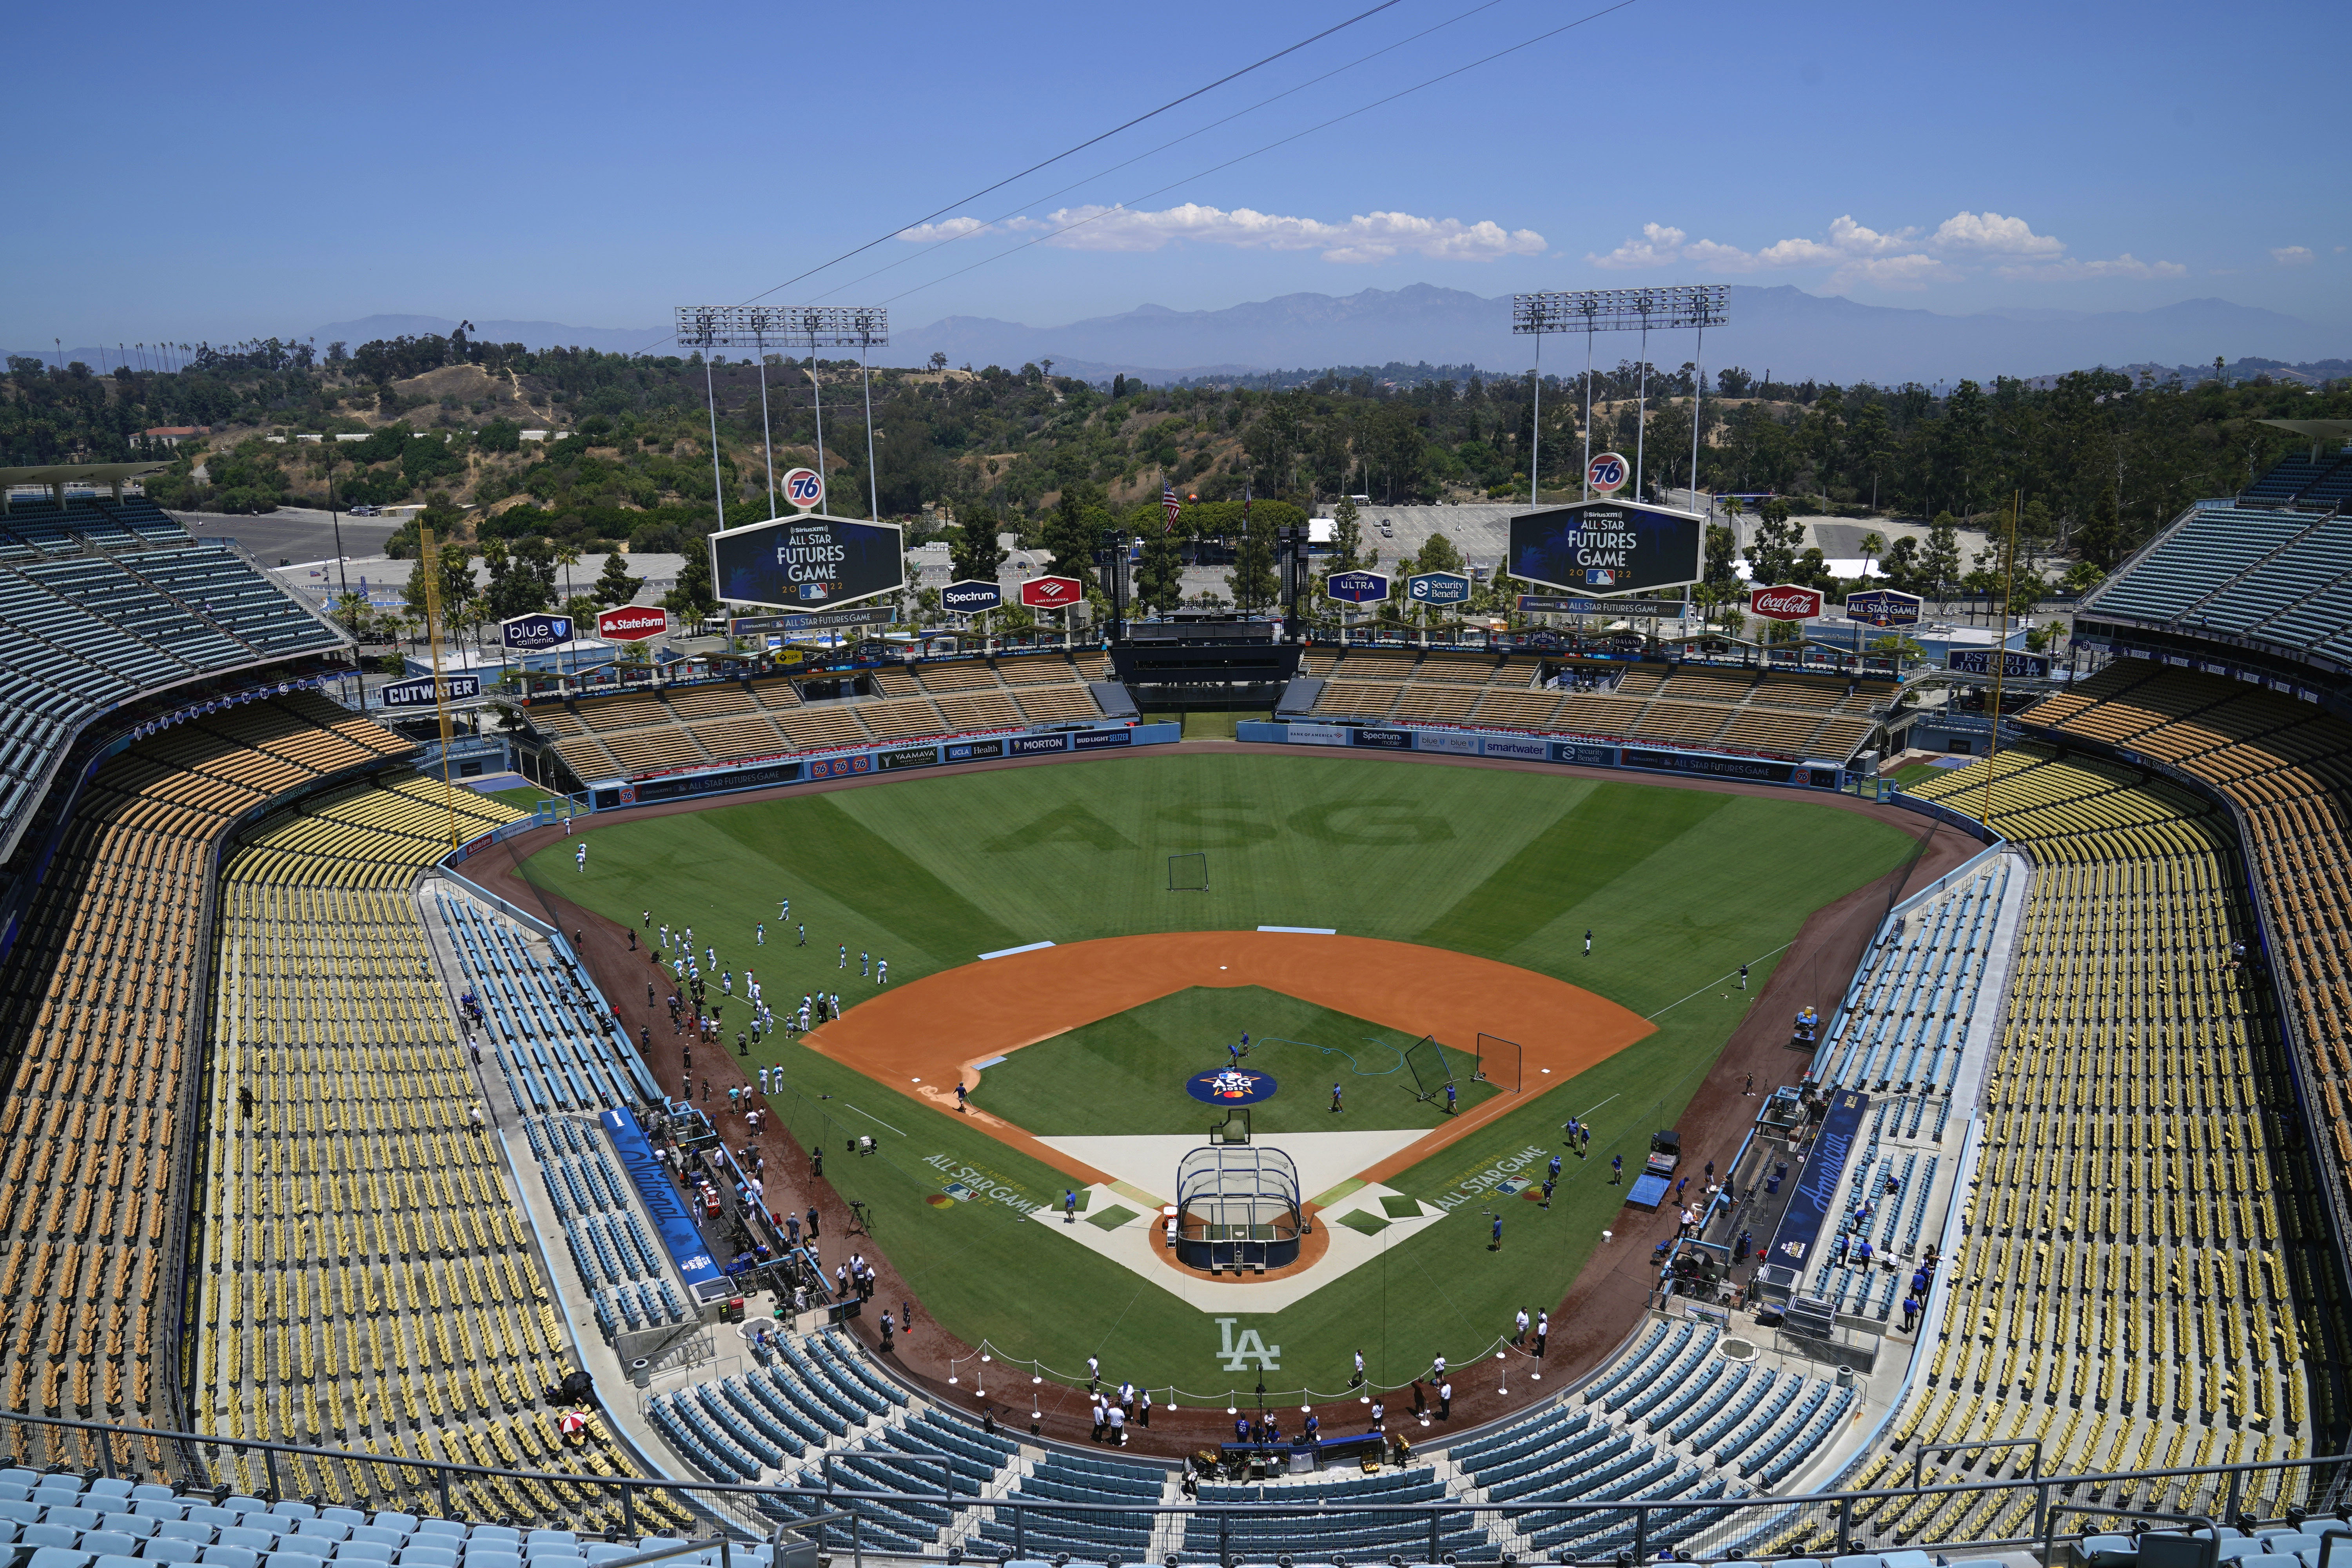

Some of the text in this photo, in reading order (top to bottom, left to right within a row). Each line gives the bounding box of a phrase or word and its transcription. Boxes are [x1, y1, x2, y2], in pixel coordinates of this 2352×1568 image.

[1592, 461, 1621, 484] 76
[790, 475, 819, 499] 76
[1581, 519, 1624, 530] ALL STAR
[789, 534, 831, 545] ALL STAR
[1568, 530, 1637, 549] FUTURES
[777, 545, 845, 564] FUTURES
[1577, 548, 1626, 566] GAME
[788, 564, 836, 581] GAME
[1432, 581, 1464, 591] Security
[947, 592, 995, 604] Spectrum
[1432, 590, 1459, 598] Benefit
[1584, 602, 1601, 610] STAR
[1603, 603, 1634, 612] FUTURES
[1635, 604, 1657, 613] GAME
[1757, 593, 1815, 613] Coca-Cola
[1849, 603, 1916, 615] ALL STAR GAME
[786, 618, 798, 627] ALL
[800, 617, 818, 626] STAR
[819, 613, 849, 624] FUTURES
[849, 613, 871, 621] GAME
[510, 623, 548, 639] blue
[1531, 633, 1541, 642] JIM
[1542, 632, 1555, 642] BEAM
[517, 637, 554, 646] california
[2136, 621, 2309, 663] DODGER STADIUM CLUB
[1964, 652, 2025, 666] ESTREL
[1956, 662, 2021, 675] JALISCO
[388, 680, 474, 703] CUTWATER
[2307, 693, 2316, 702] 2020
[1109, 733, 1129, 741] SELTZER
[1363, 731, 1399, 741] Spectrum
[974, 746, 998, 754] Health
[1024, 739, 1062, 750] MORTON
[1487, 743, 1544, 755] smartwater
[1577, 747, 1604, 757] Security
[1577, 754, 1600, 762] Benefit
[815, 764, 826, 774] 76
[835, 761, 847, 771] 76
[854, 758, 866, 769] 76
[1674, 759, 1769, 776] ALL STAR FUTURES GAME
[1797, 772, 1808, 781] 76
[2152, 761, 2162, 772] STAR
[2163, 765, 2180, 781] FUTURES
[2179, 773, 2190, 785] GAME
[689, 771, 779, 790] ALL STAR FUTURES GAME
[271, 799, 281, 808] STAR
[281, 790, 298, 803] FUTURES
[298, 784, 311, 795] GAME
[622, 790, 633, 801] 76
[979, 799, 1457, 852] ASG
[1213, 1078, 1252, 1088] ASG
[968, 1160, 1027, 1191] LOS ANGELES
[1444, 1154, 1502, 1187] LOS ANGELES
[1798, 1132, 1854, 1214] American
[922, 1154, 1044, 1215] ALL STAR GAME
[1434, 1145, 1548, 1211] ALL STAR GAME
[1215, 1318, 1280, 1371] LA
